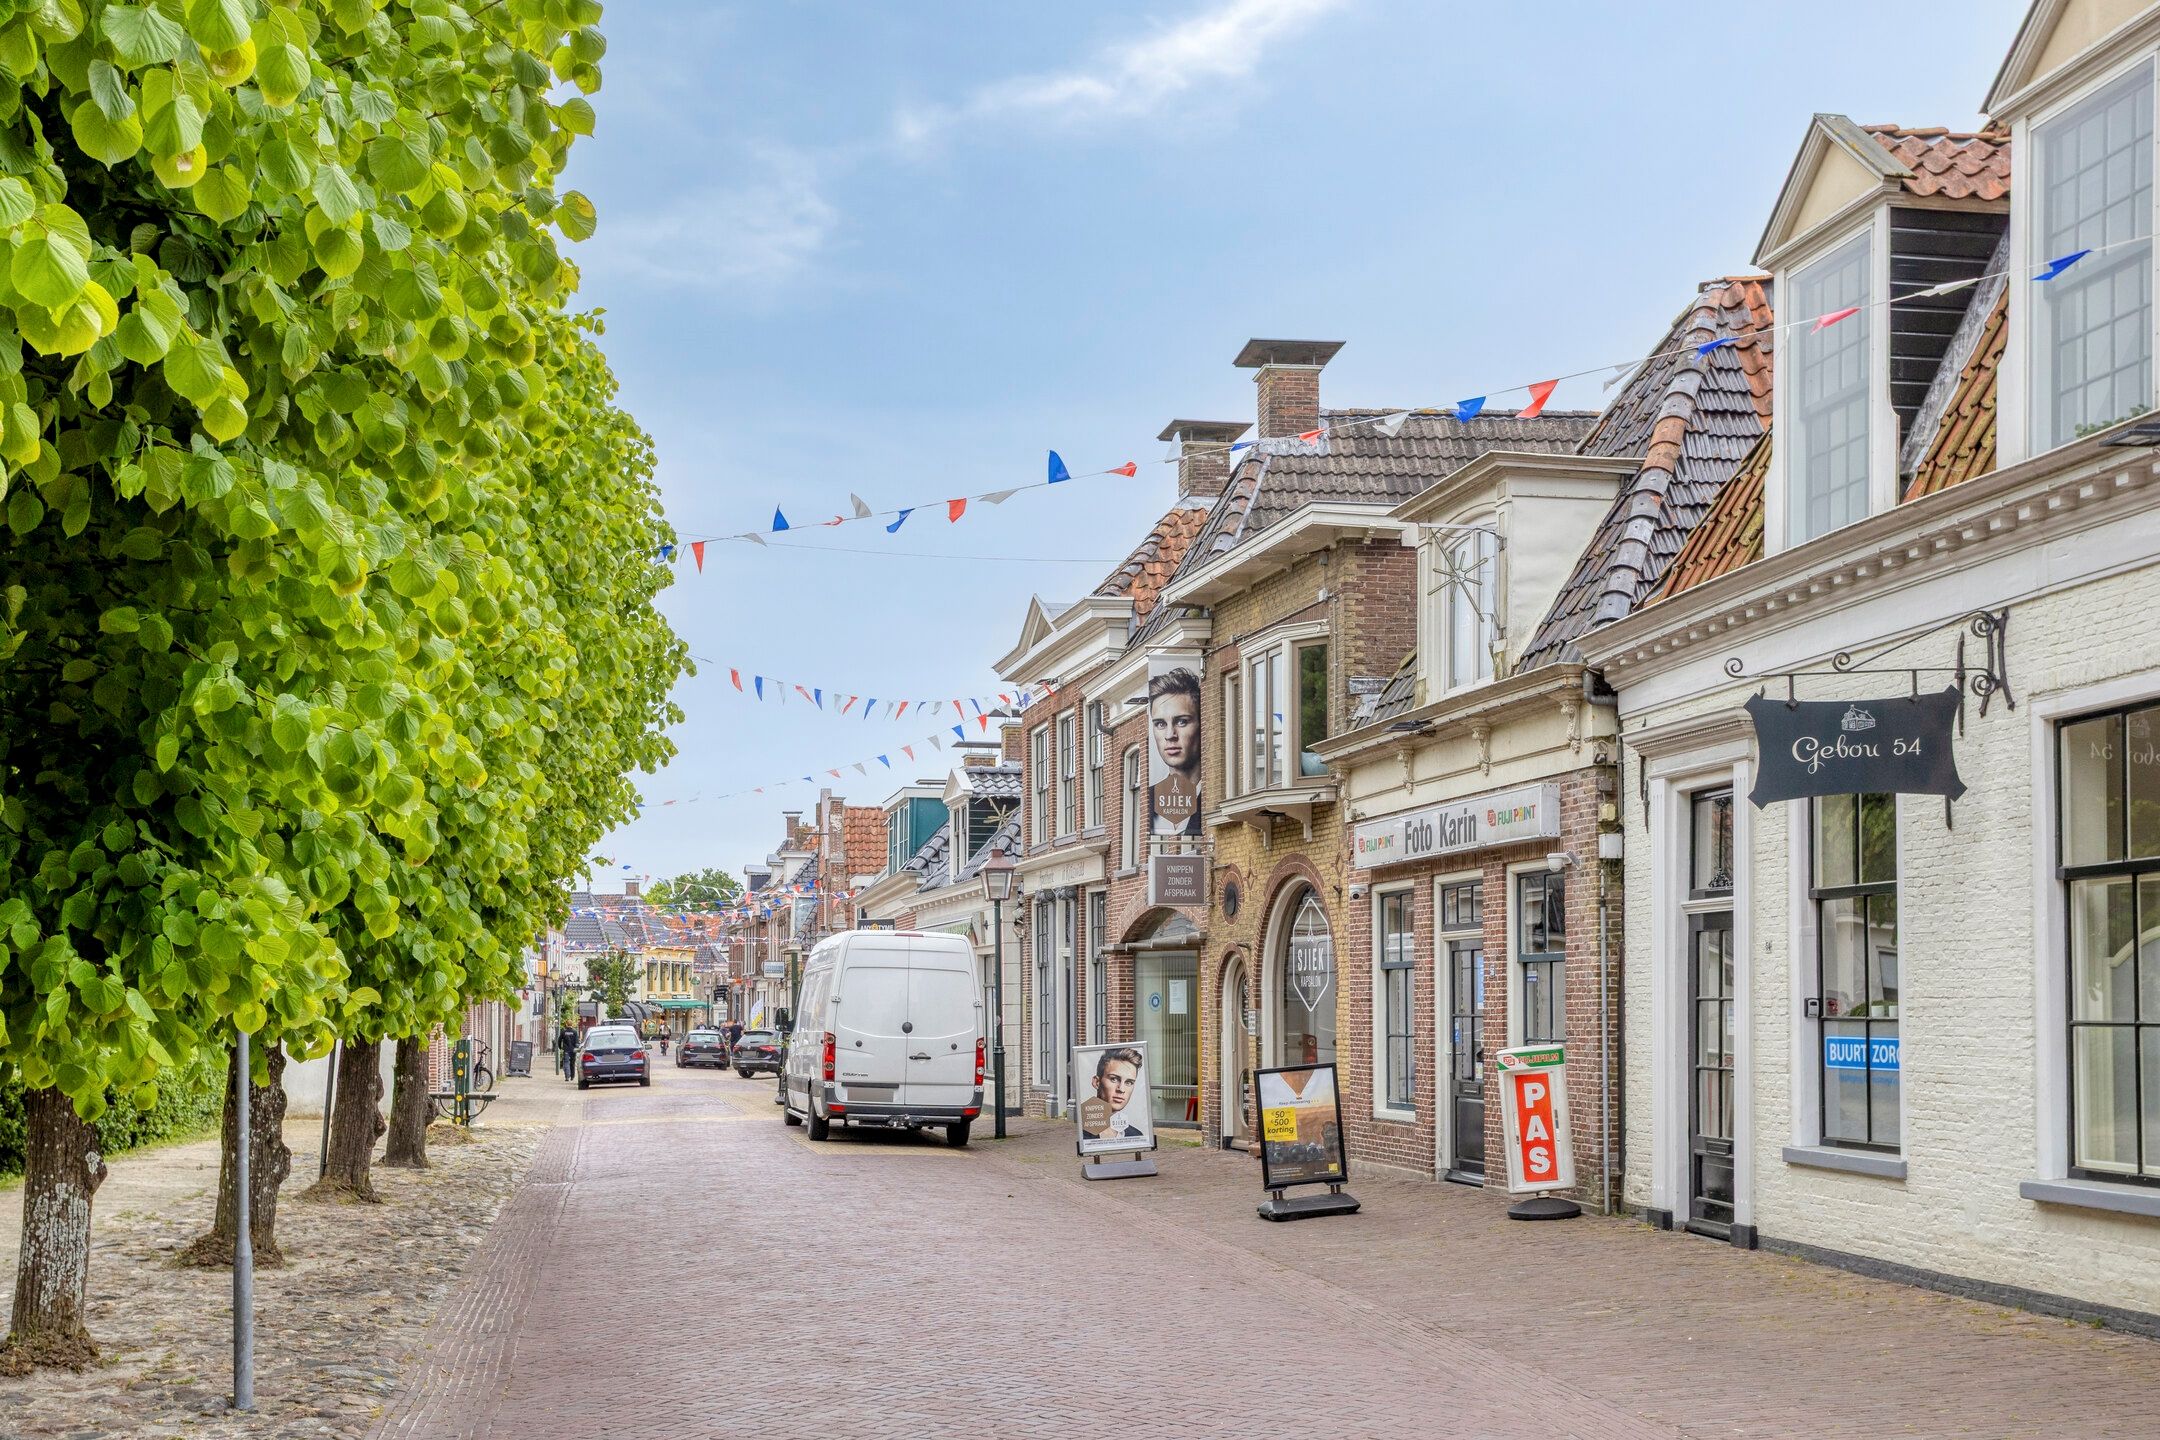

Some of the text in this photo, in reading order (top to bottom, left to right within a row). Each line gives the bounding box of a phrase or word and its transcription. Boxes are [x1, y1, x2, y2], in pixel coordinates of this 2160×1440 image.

[1791, 734, 1922, 775] Gebou 54
[1159, 795, 1192, 807] SJIEK
[1497, 809, 1512, 826] FUJI
[1404, 807, 1477, 854] Foto Karin
[1166, 865, 1194, 874] KNIPPEN
[1167, 877, 1193, 886] ZONDER
[1164, 889, 1197, 898] AFSPRAAK
[1297, 947, 1324, 972] SJIEK
[1300, 975, 1322, 987] KAPSALON
[1518, 1053, 1559, 1064] FUJIFILM
[1829, 1043, 1867, 1062] BUURT
[1085, 1104, 1105, 1112] KNIPPEN
[1084, 1120, 1107, 1128] AFSPRAAK
[1266, 1125, 1295, 1135] korting
[1523, 1082, 1551, 1174] PAS
